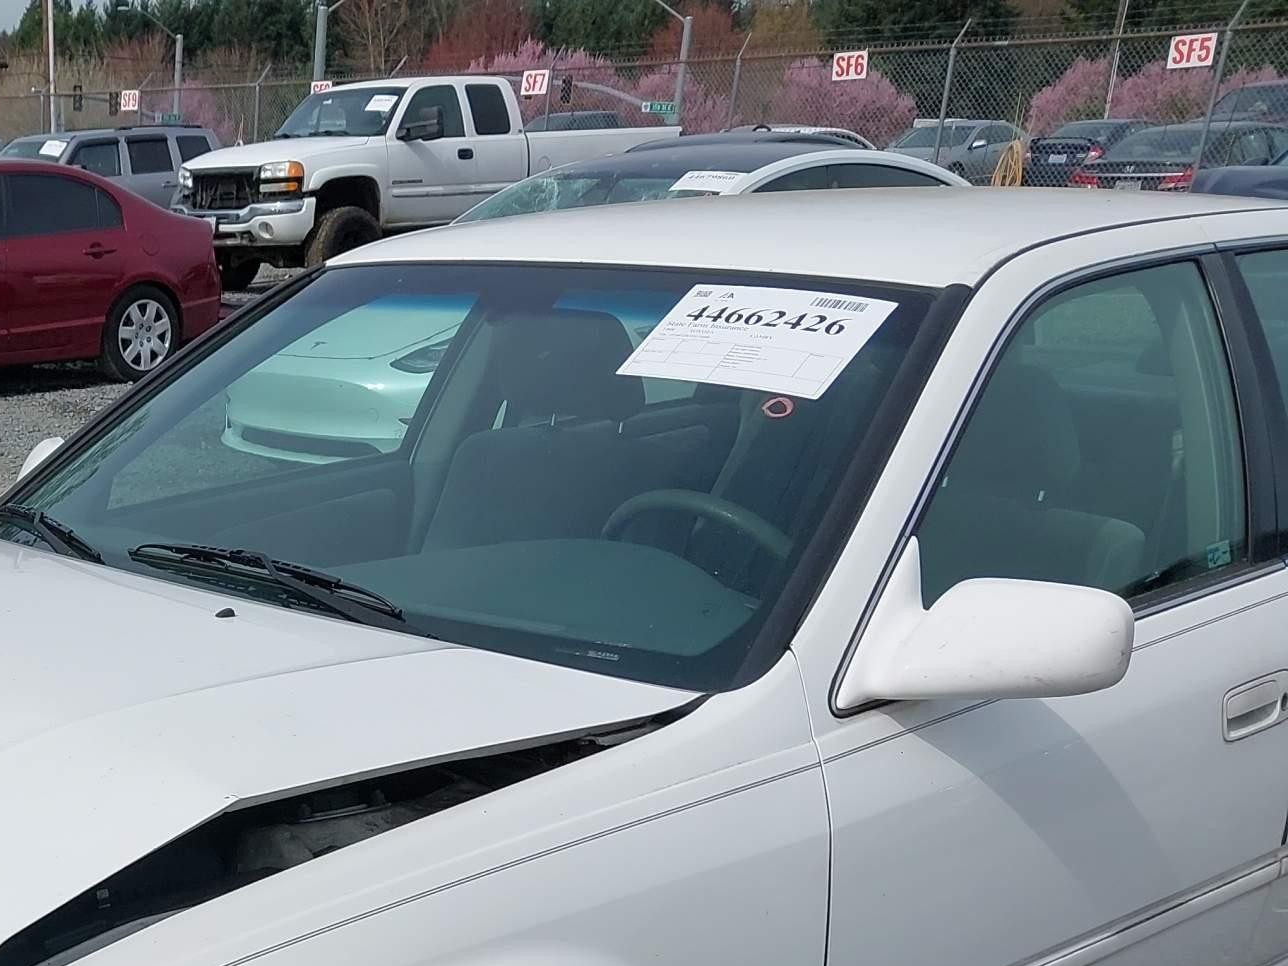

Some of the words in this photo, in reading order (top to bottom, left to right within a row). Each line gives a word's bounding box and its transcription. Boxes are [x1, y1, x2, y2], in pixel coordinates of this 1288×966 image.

[1172, 37, 1212, 64] SF5
[835, 54, 864, 77] SF6
[524, 73, 546, 92] SF7
[122, 92, 137, 109] SF9
[686, 305, 853, 335] 44662426
